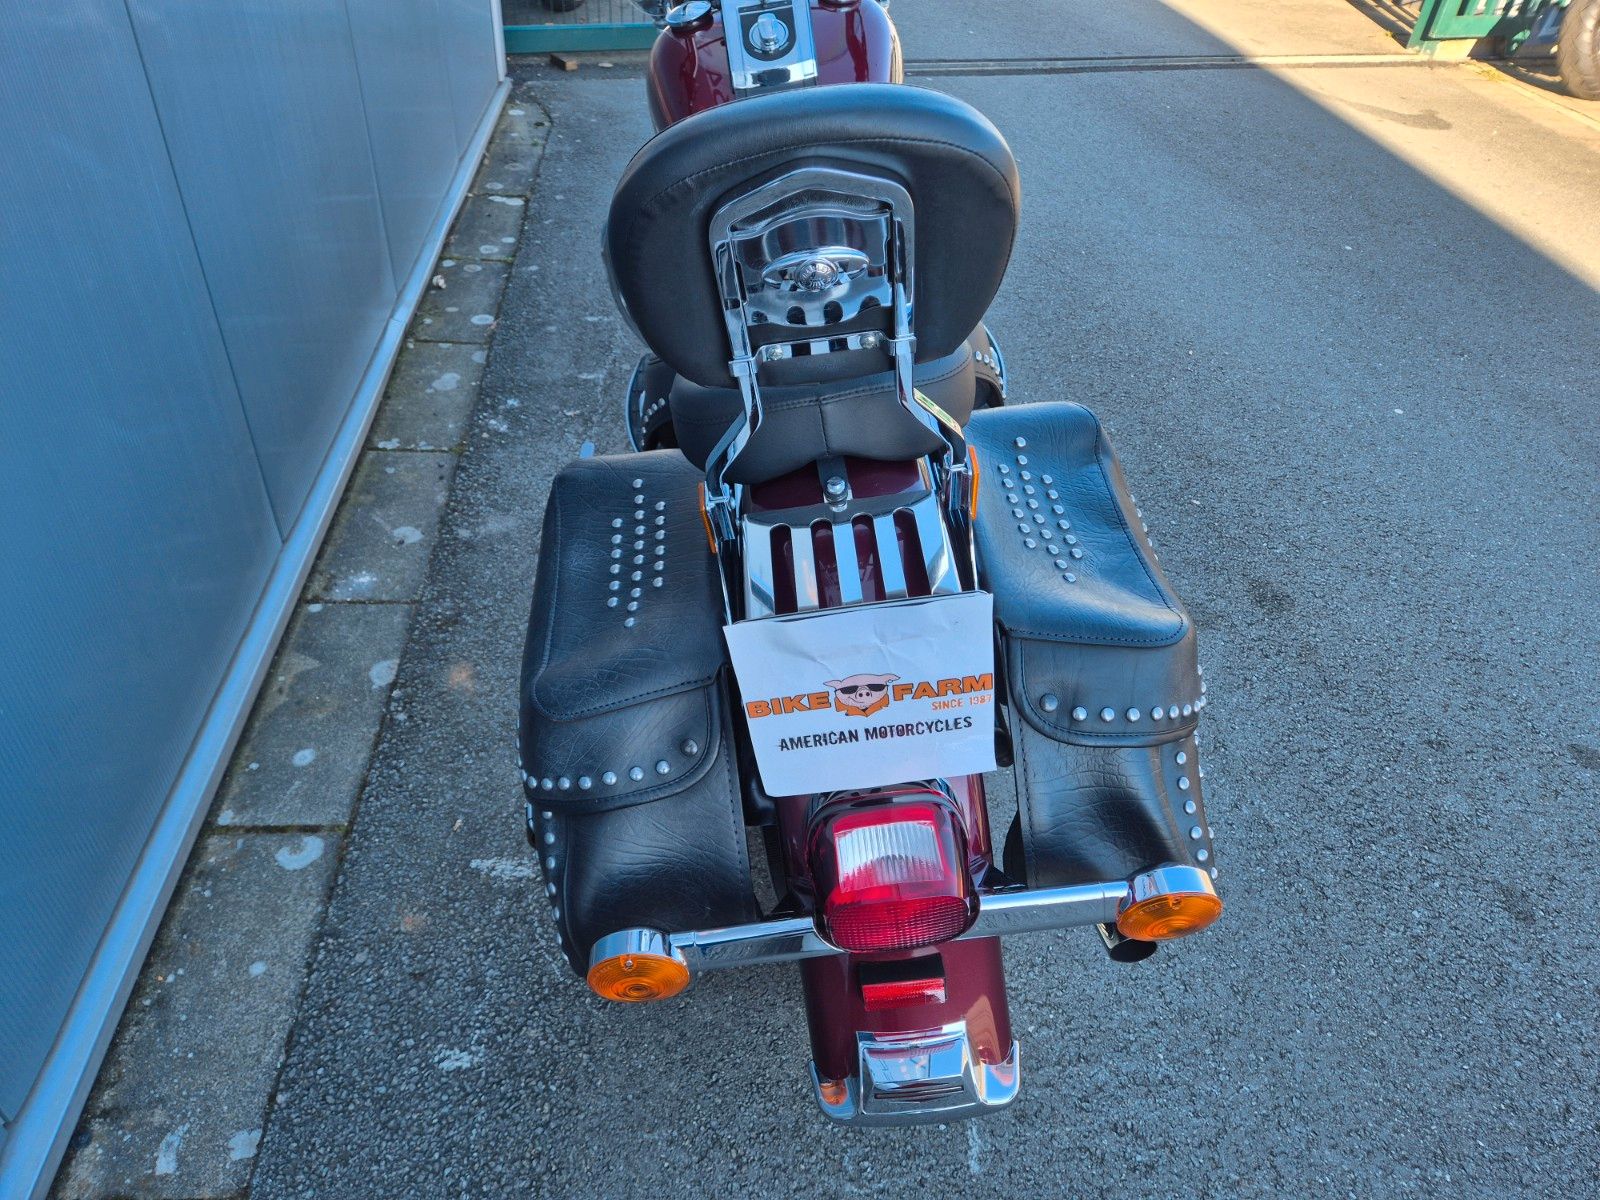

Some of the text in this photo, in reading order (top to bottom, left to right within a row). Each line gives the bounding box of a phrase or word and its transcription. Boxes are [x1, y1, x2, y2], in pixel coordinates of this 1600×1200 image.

[746, 673, 993, 719] BIKE FARM
[931, 698, 963, 711] SINCE
[779, 716, 973, 752] AMERICAN MOTORCYCLES
